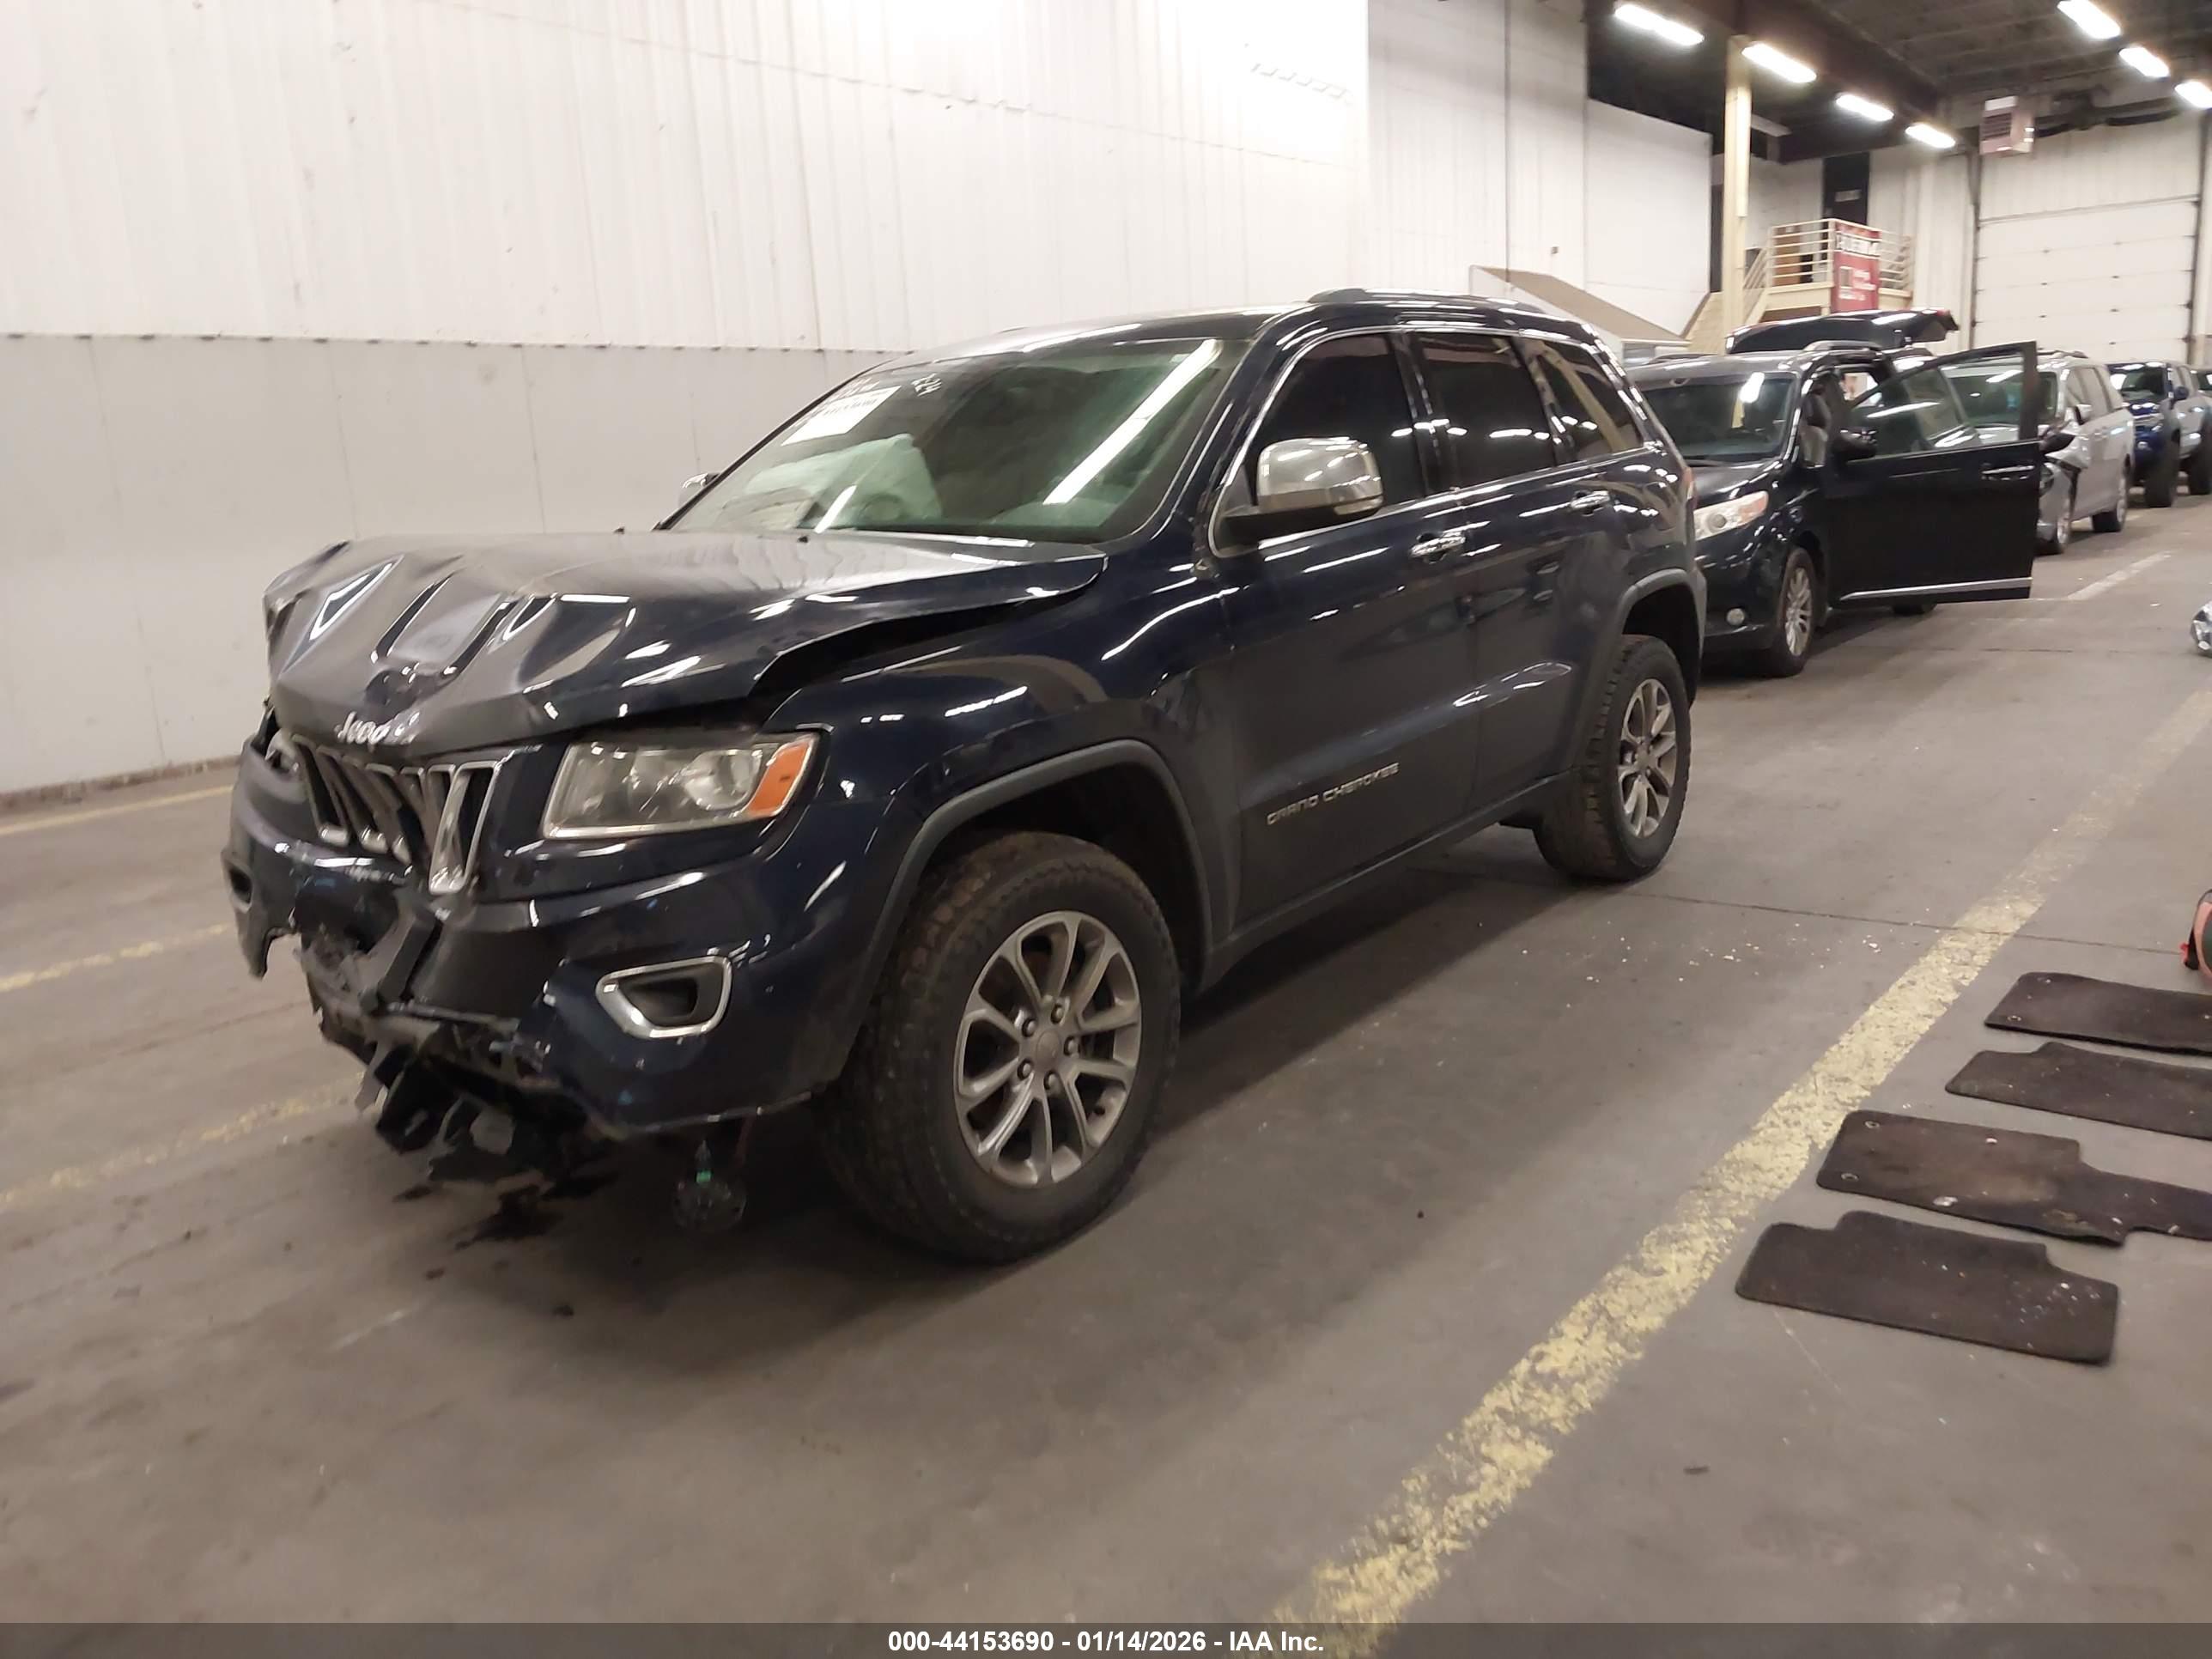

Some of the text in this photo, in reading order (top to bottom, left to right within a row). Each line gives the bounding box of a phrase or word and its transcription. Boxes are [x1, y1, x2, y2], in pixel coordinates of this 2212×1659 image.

[333, 711, 391, 753] Jeep
[1267, 762, 1400, 825] GRAND CHEROKEE
